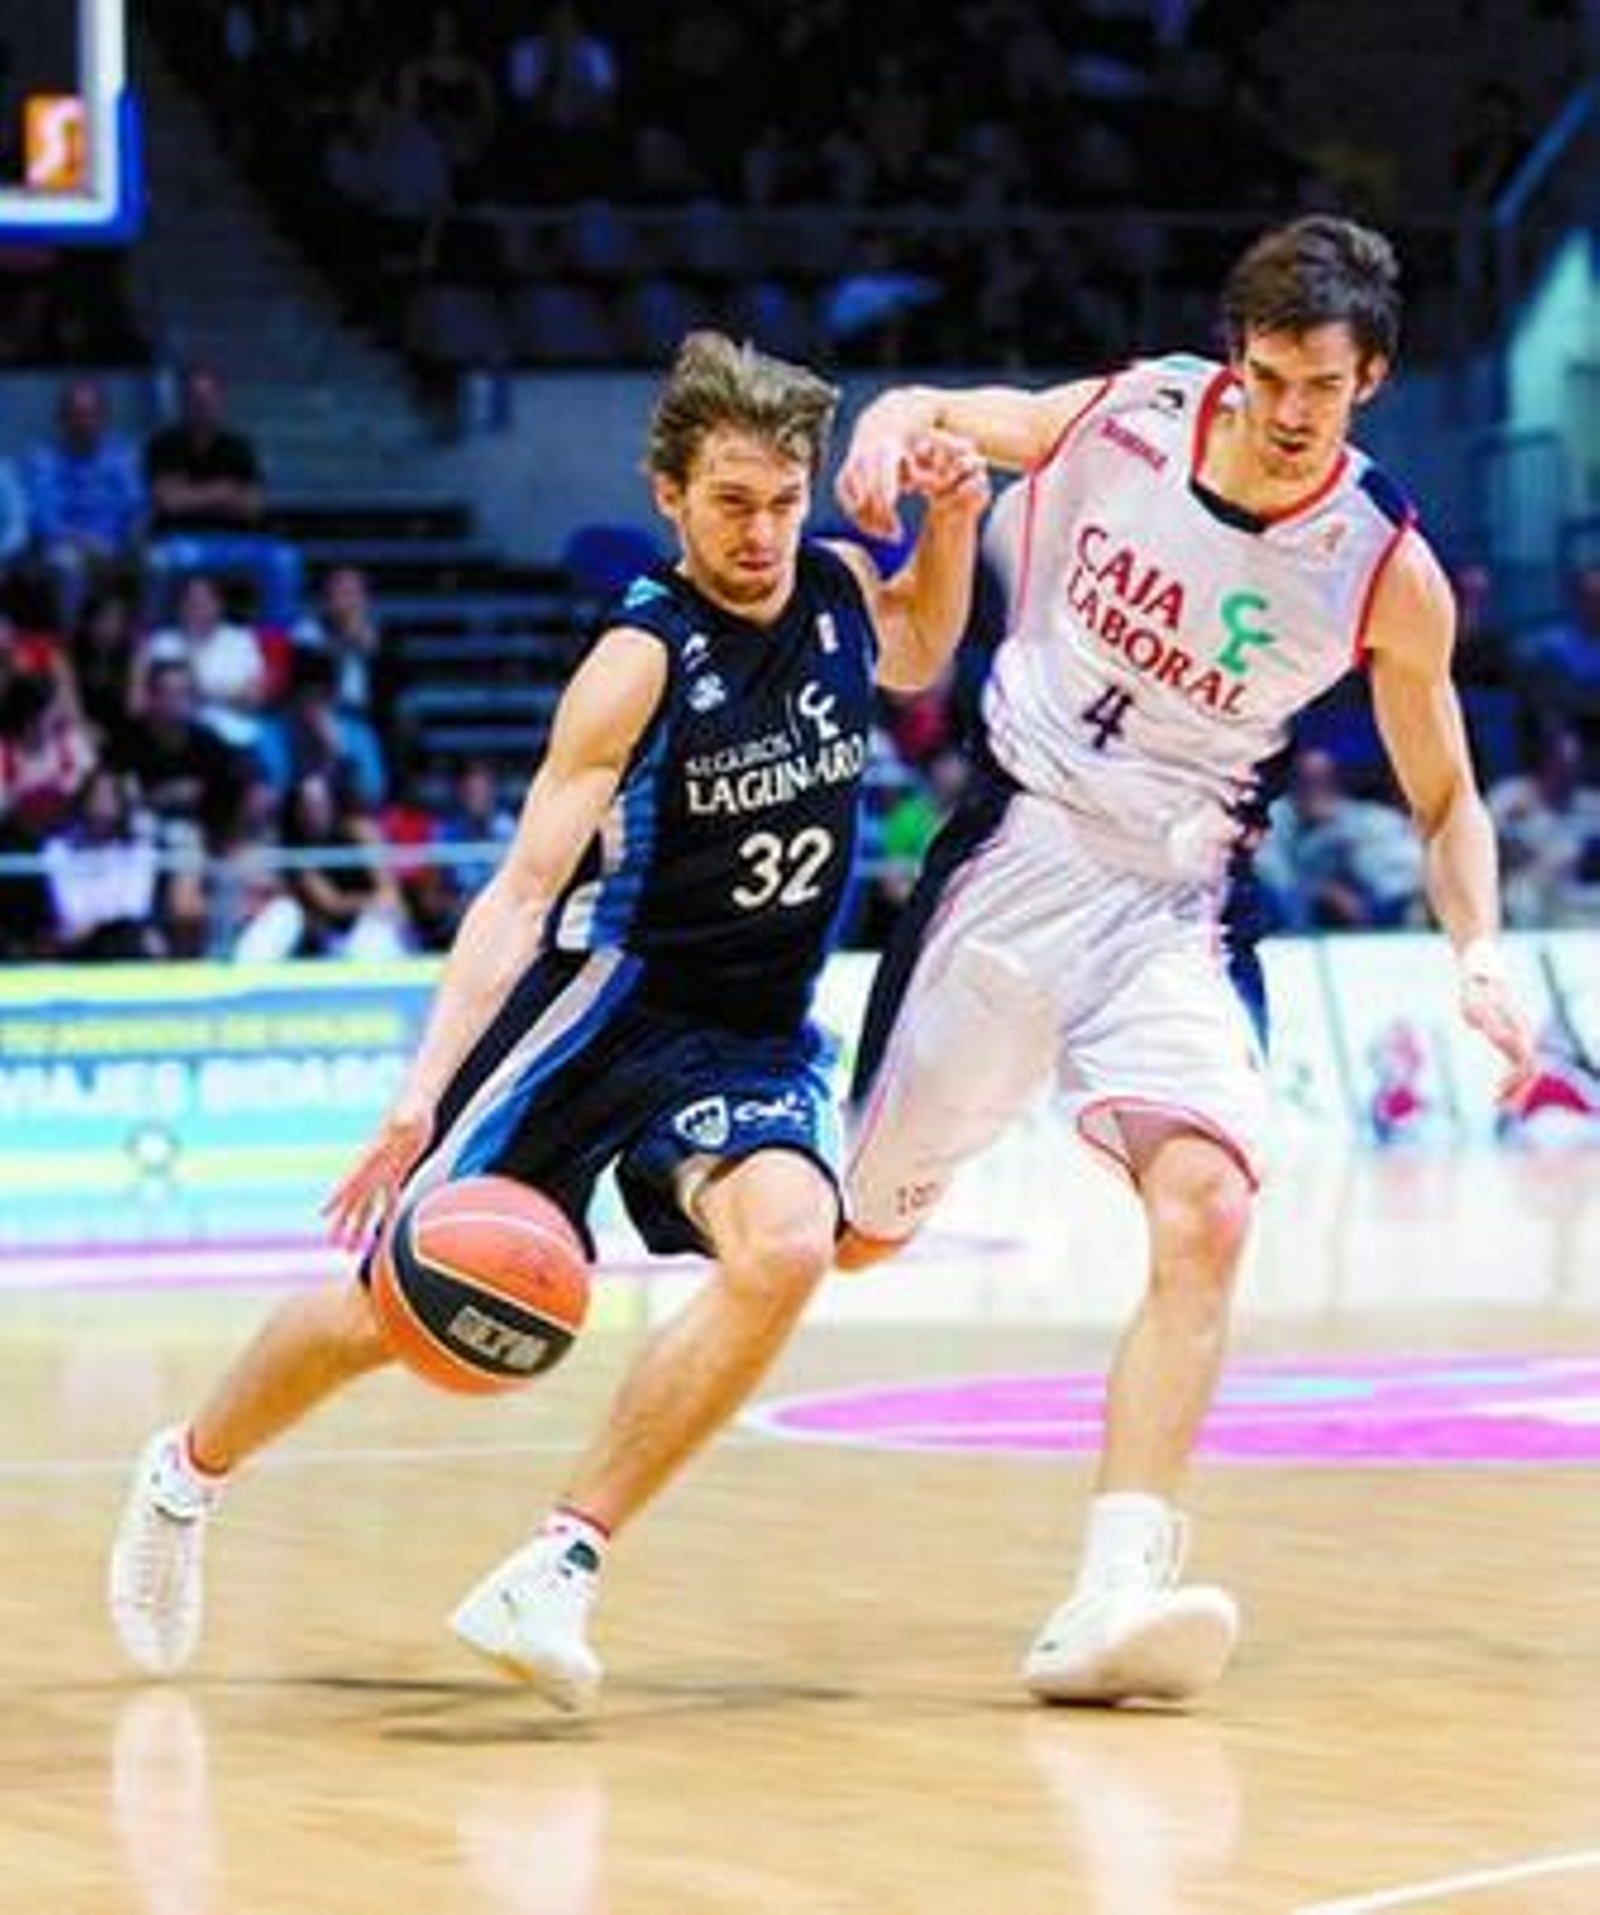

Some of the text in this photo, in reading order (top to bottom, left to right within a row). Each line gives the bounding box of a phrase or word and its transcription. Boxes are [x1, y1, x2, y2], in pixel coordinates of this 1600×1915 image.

[1077, 525, 1185, 630] CAJA
[1068, 566, 1246, 714] LABORAL
[1082, 685, 1134, 749] 4
[732, 827, 833, 908] 32
